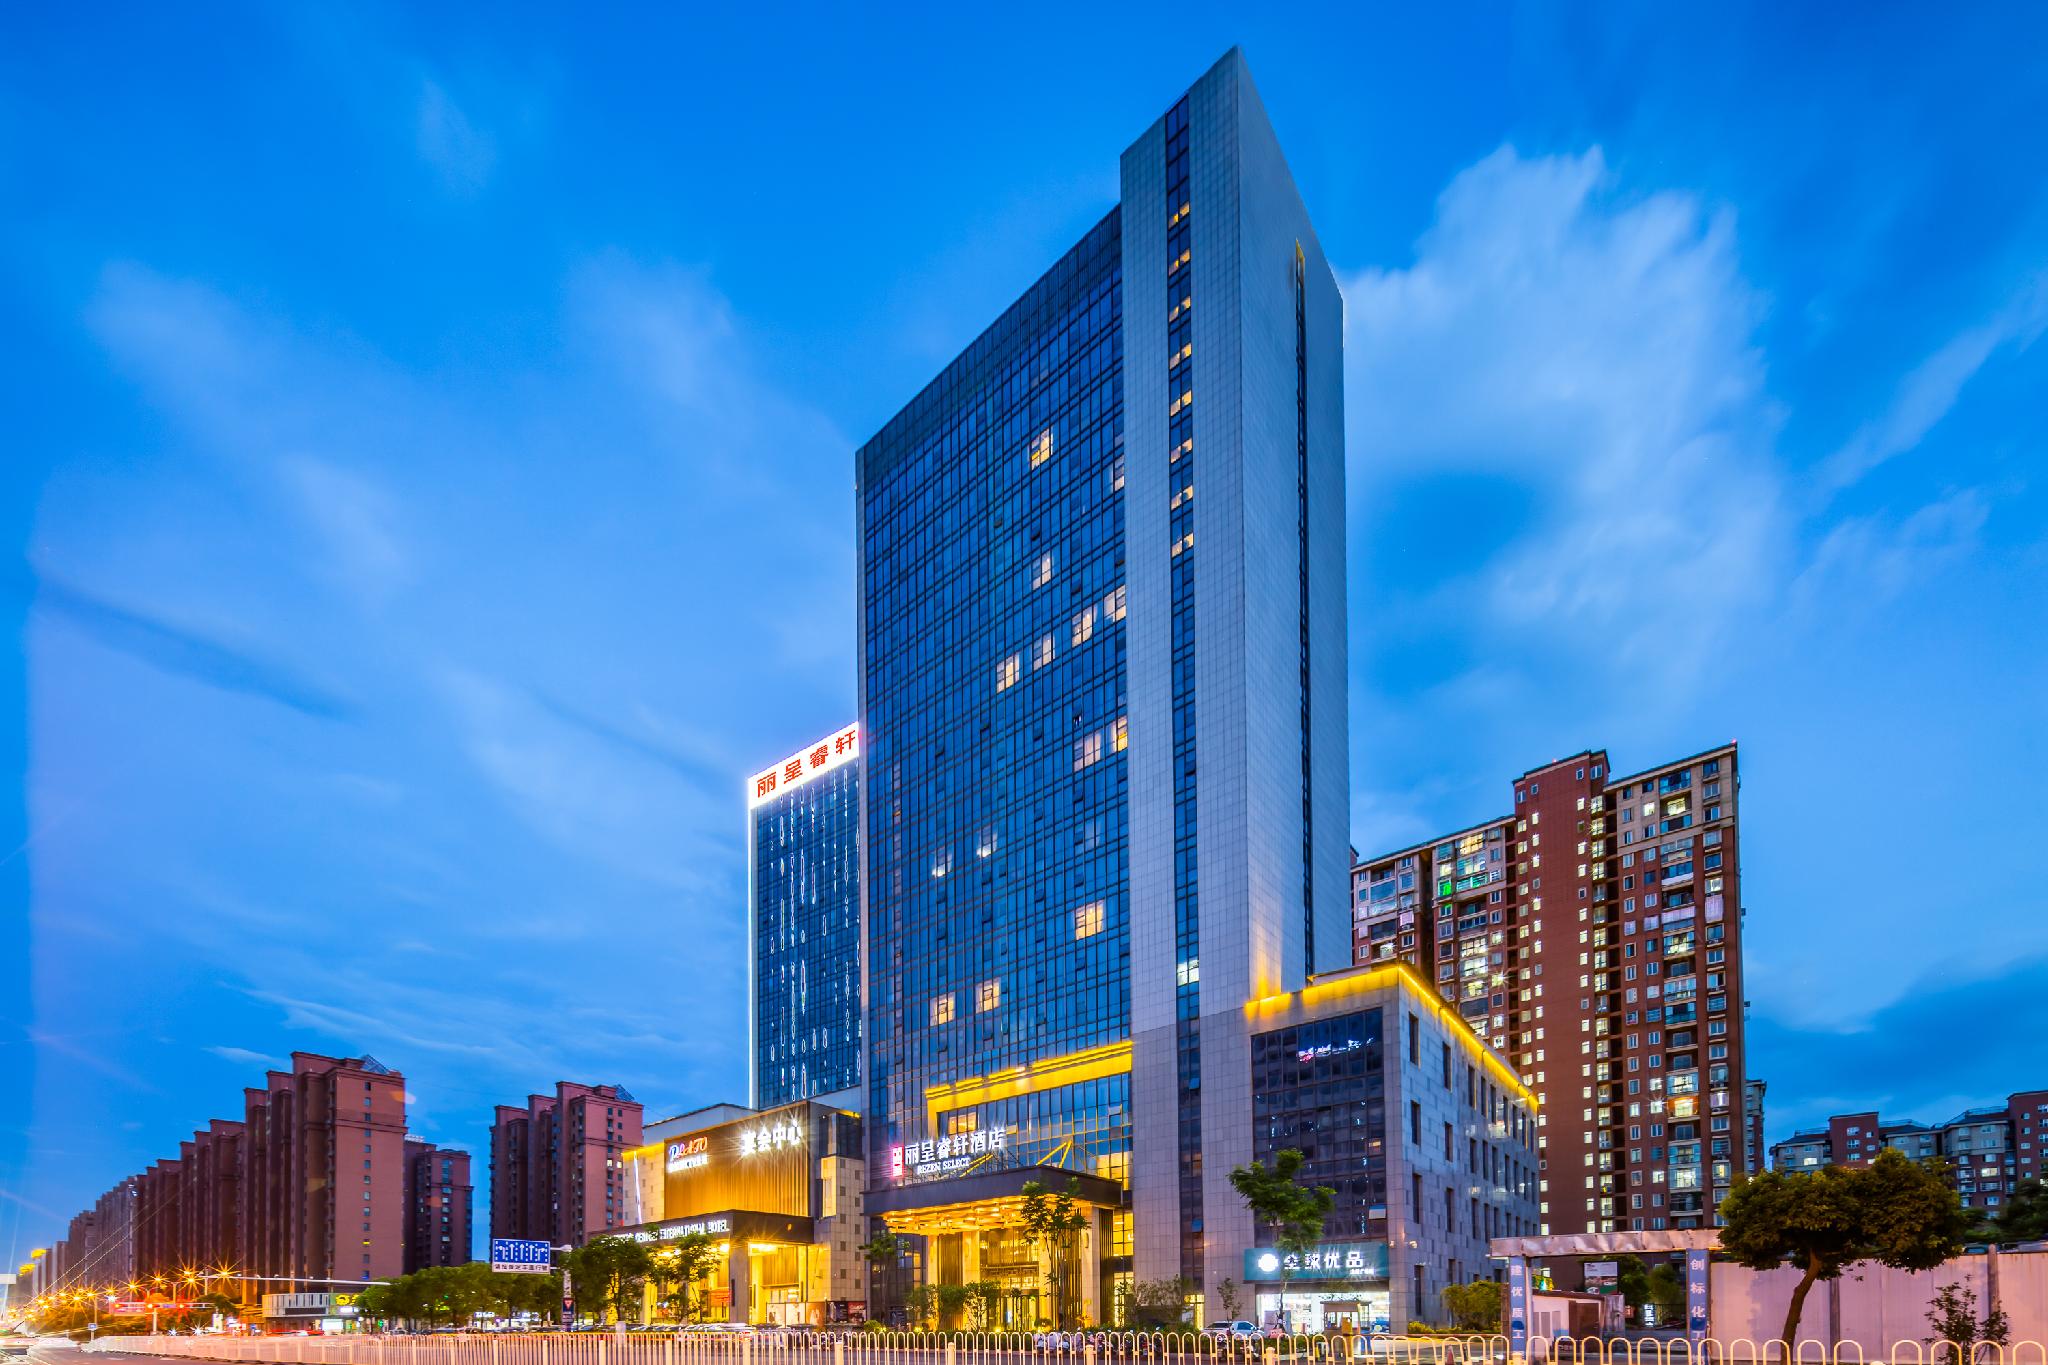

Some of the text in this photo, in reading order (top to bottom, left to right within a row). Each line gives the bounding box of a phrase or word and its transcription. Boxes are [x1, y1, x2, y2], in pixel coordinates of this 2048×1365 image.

[757, 730, 856, 798] 丽呈睿轩
[740, 1119, 802, 1156] 宴会中心
[905, 1127, 1006, 1165] 丽呈睿轩酒店
[943, 1157, 971, 1170] SELECT
